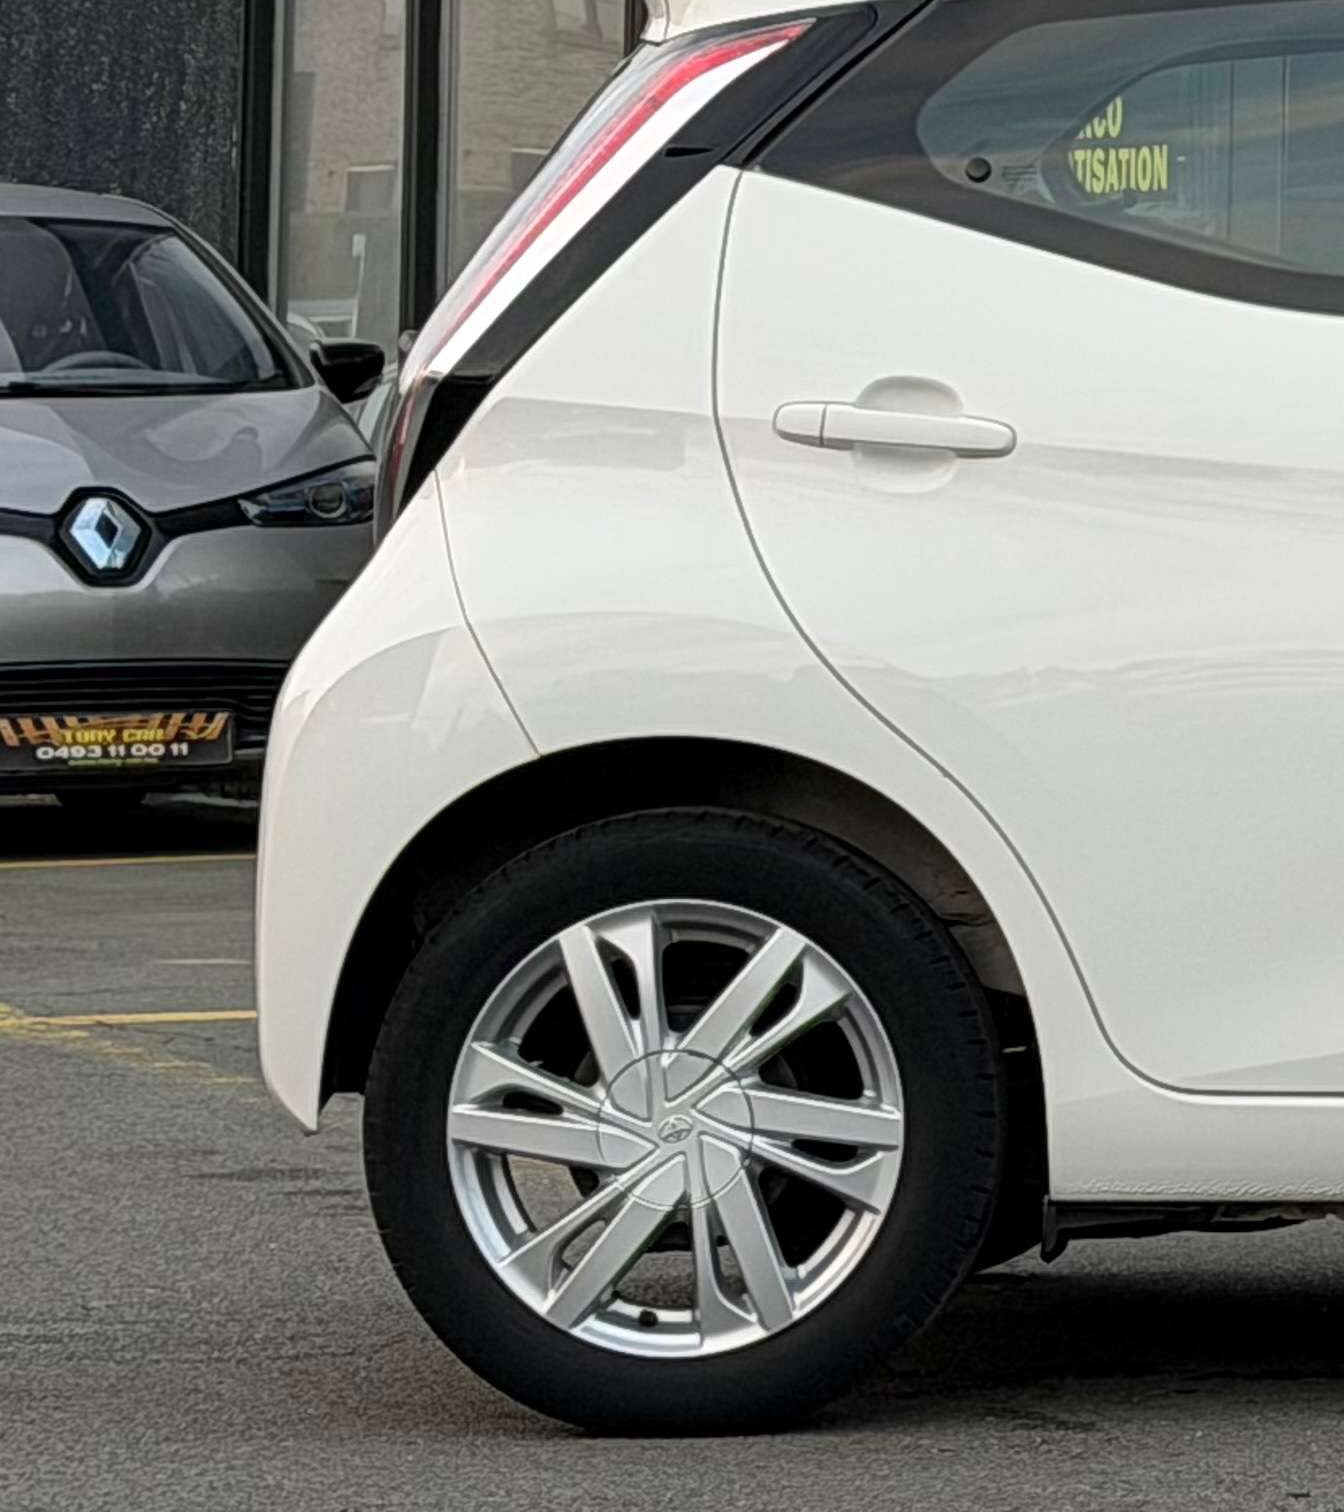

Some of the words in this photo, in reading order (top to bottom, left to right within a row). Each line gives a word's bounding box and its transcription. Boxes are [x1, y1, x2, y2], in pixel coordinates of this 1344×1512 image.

[1068, 144, 1168, 194] TISATION
[35, 744, 102, 759] 0493
[107, 744, 126, 757] 11
[130, 743, 166, 757] 00
[170, 742, 189, 756] 11
